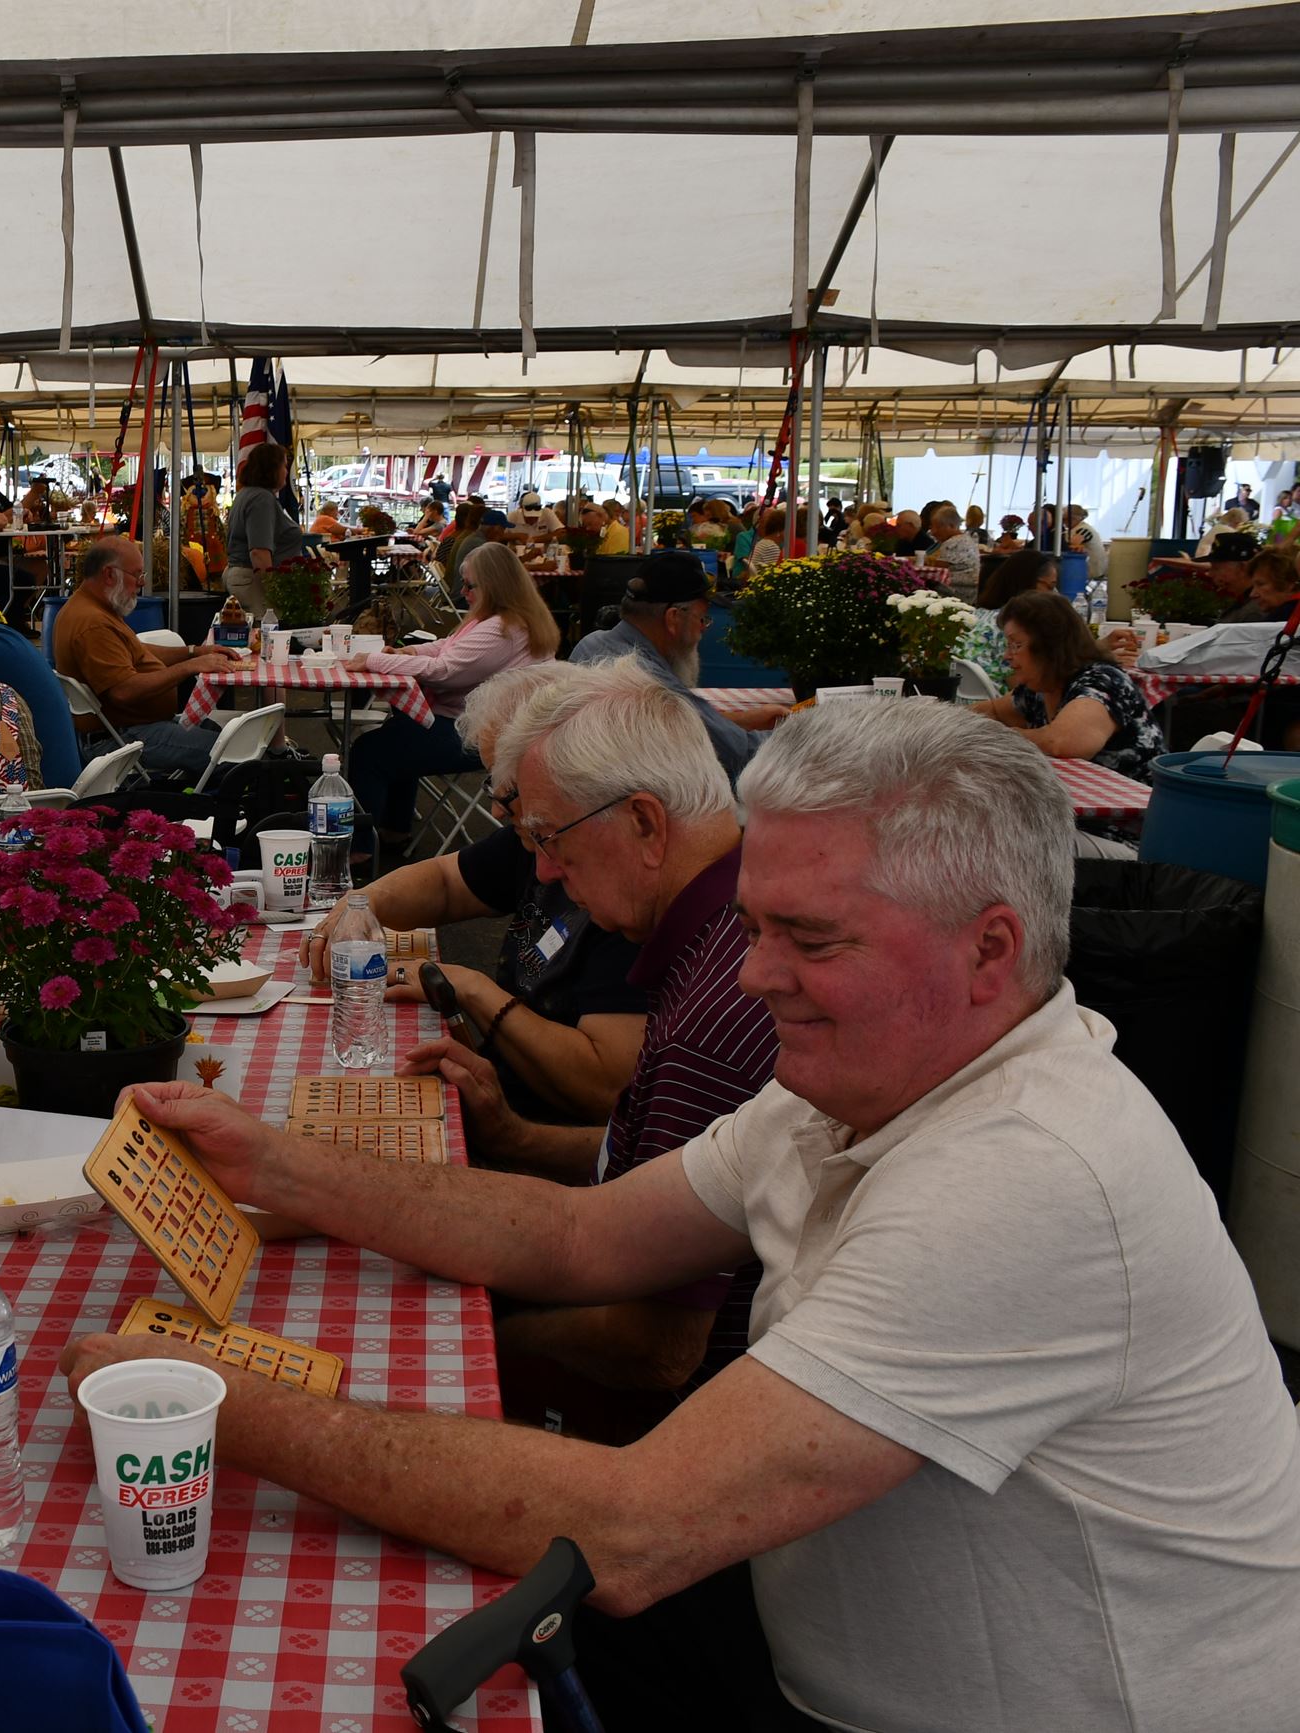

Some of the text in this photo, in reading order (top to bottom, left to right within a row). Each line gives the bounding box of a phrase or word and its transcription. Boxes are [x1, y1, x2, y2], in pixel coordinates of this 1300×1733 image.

[107, 1118, 152, 1187] BINGO
[116, 1438, 211, 1485] CASH
[119, 1474, 210, 1508] EXPRESS
[141, 1506, 197, 1526] Loans
[143, 1519, 197, 1540] Checks Cashed
